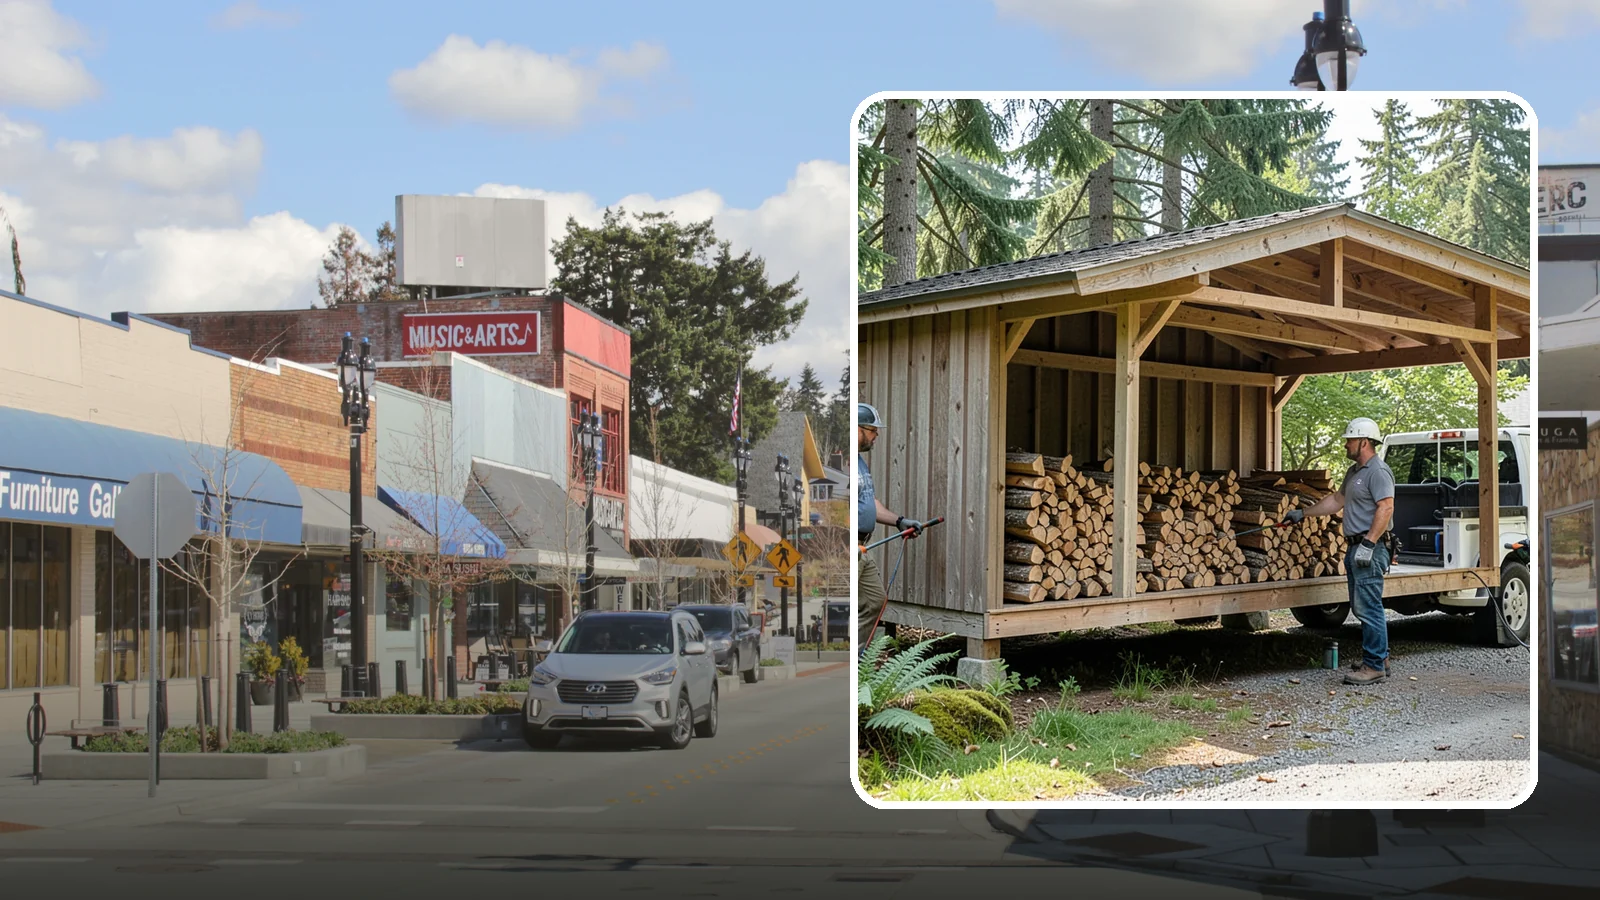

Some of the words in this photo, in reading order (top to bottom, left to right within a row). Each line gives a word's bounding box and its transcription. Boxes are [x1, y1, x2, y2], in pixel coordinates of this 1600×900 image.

[1540, 428, 1577, 437] UGA
[0, 471, 79, 515] Furniture
[89, 482, 121, 519] Gal
[453, 563, 479, 574] SUSHI
